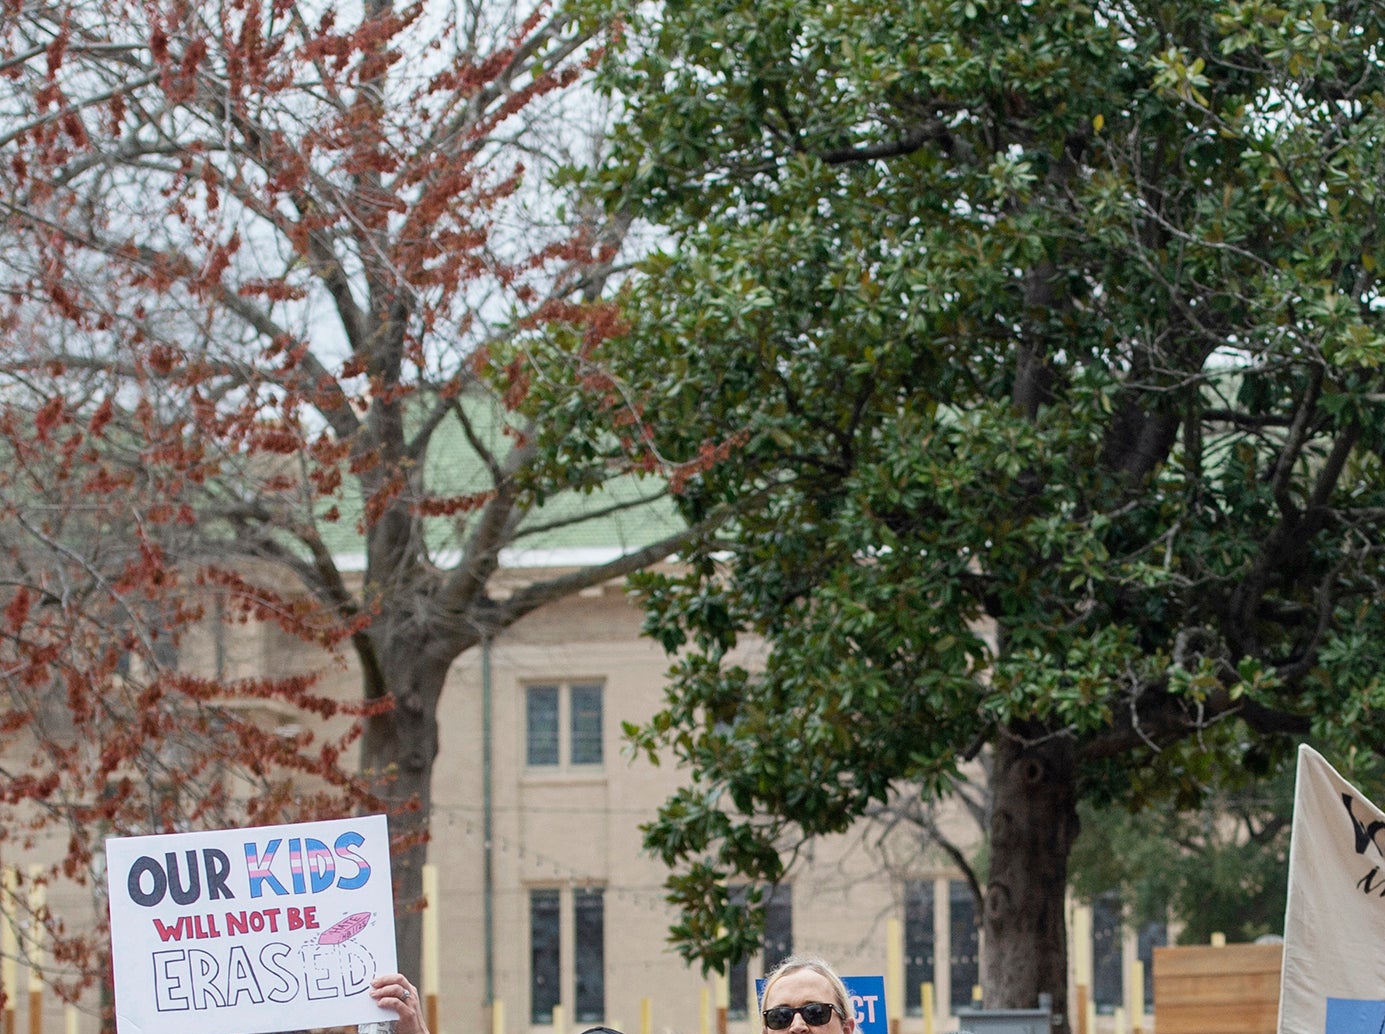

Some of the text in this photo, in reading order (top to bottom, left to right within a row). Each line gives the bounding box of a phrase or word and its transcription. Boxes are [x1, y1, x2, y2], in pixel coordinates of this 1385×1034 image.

[128, 831, 371, 907] OUR KIDS
[153, 906, 320, 942] WILL NOT BE
[328, 916, 361, 934] HATE
[152, 941, 377, 1012] ERASED
